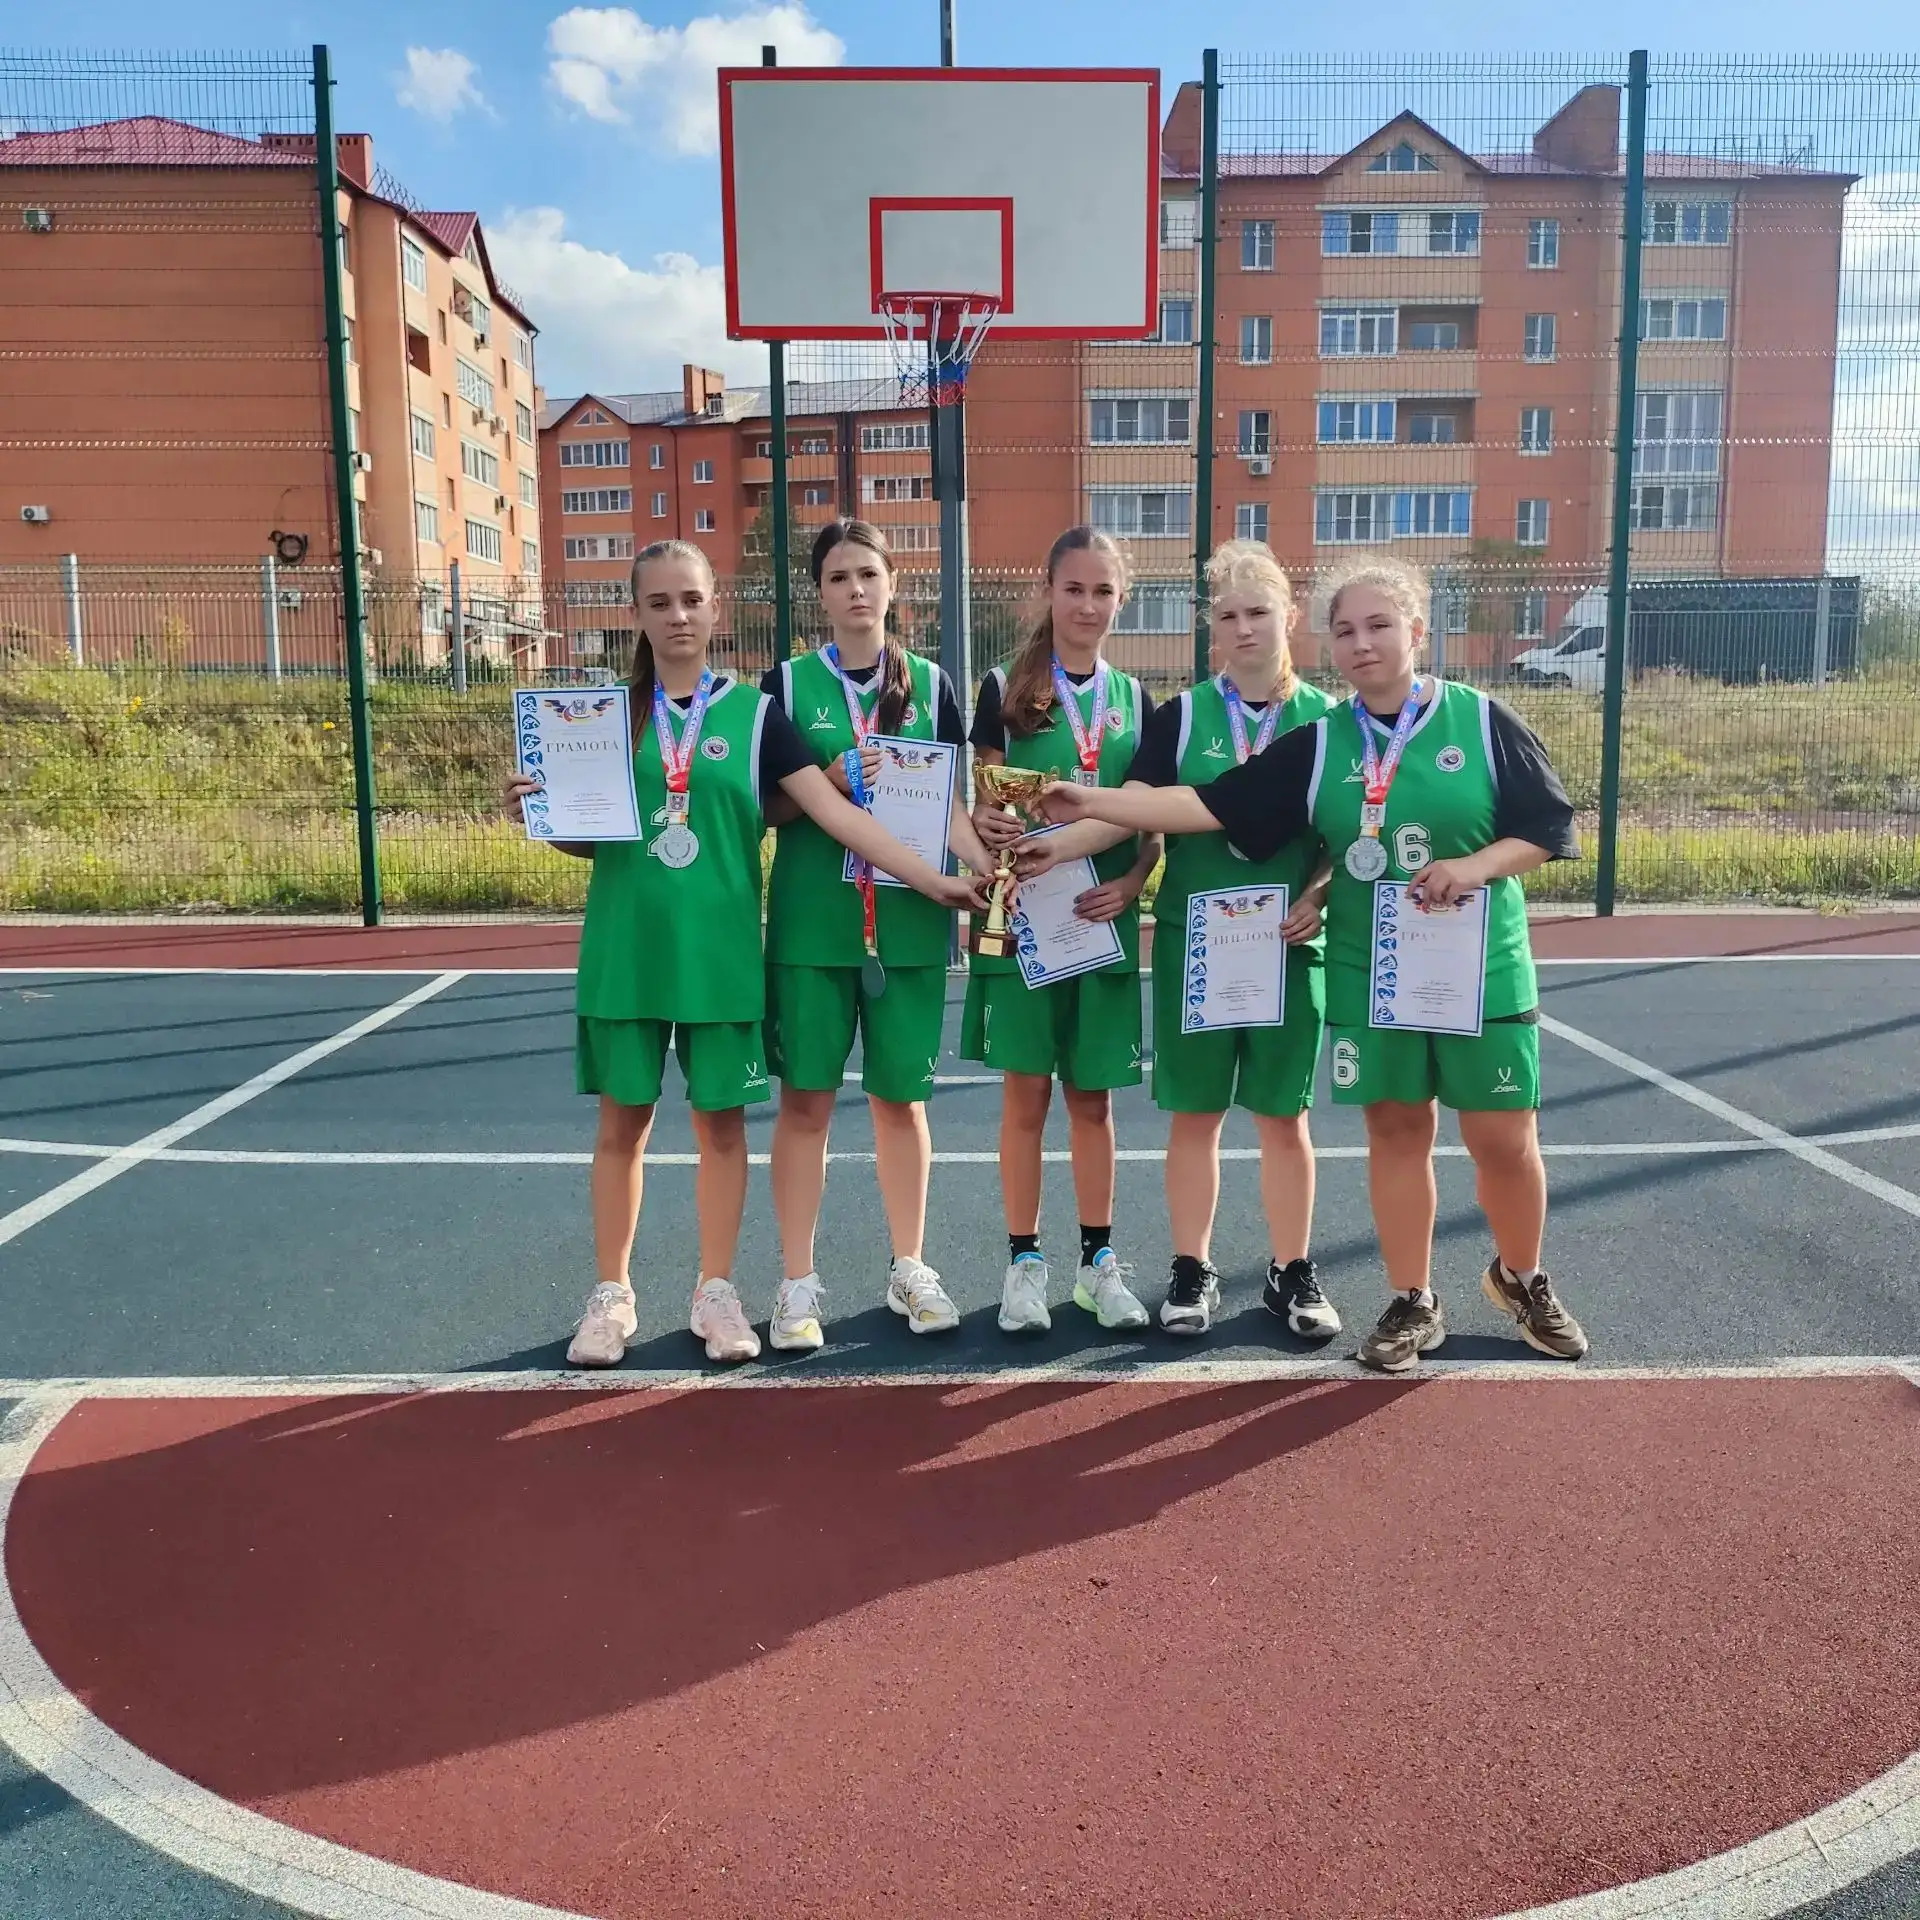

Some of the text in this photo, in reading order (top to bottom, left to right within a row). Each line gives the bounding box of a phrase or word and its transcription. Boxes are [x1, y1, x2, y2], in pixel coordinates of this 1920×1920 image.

[545, 739, 620, 753] ГРАМОТА
[878, 785, 942, 801] ГРАМОТА
[1392, 822, 1433, 874] 6
[1209, 930, 1274, 948] ДИПЛОМ
[1333, 1037, 1360, 1089] 6
